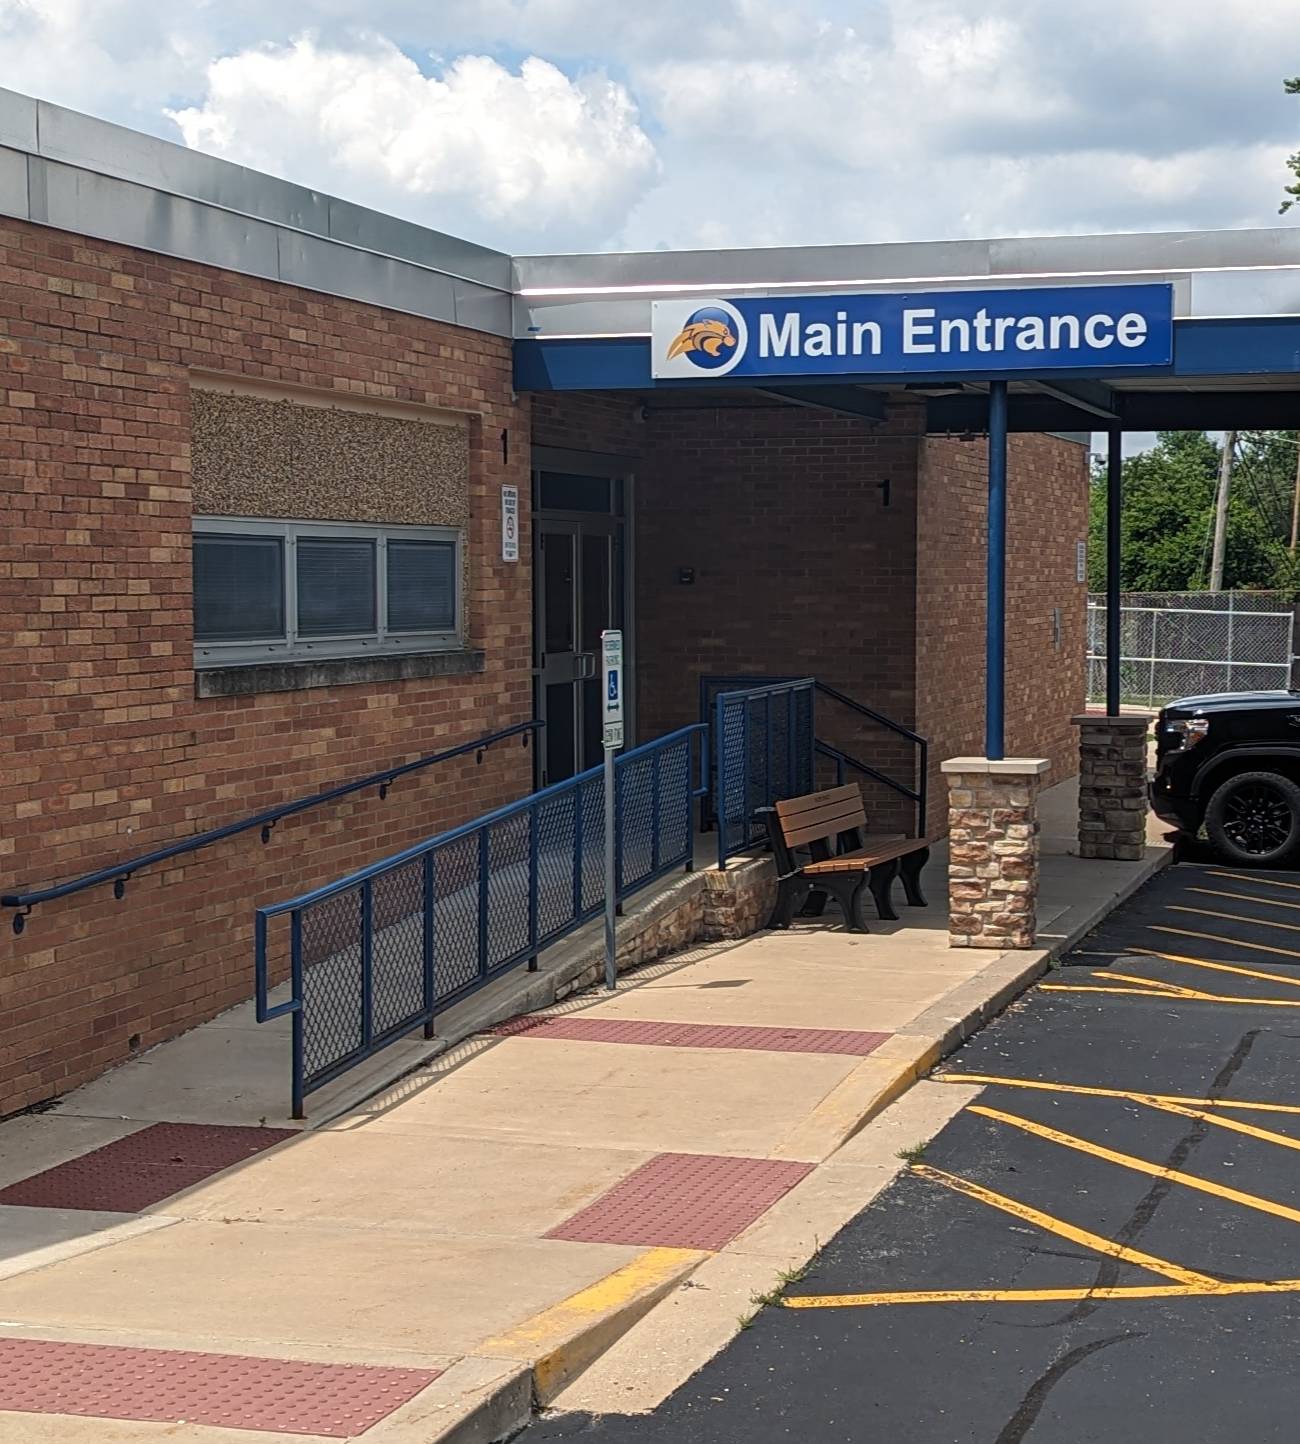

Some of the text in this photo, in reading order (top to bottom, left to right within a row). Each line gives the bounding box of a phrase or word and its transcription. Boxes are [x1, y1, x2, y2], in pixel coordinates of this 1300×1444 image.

[759, 308, 1148, 358] Main Entrance
[877, 479, 890, 506] 1
